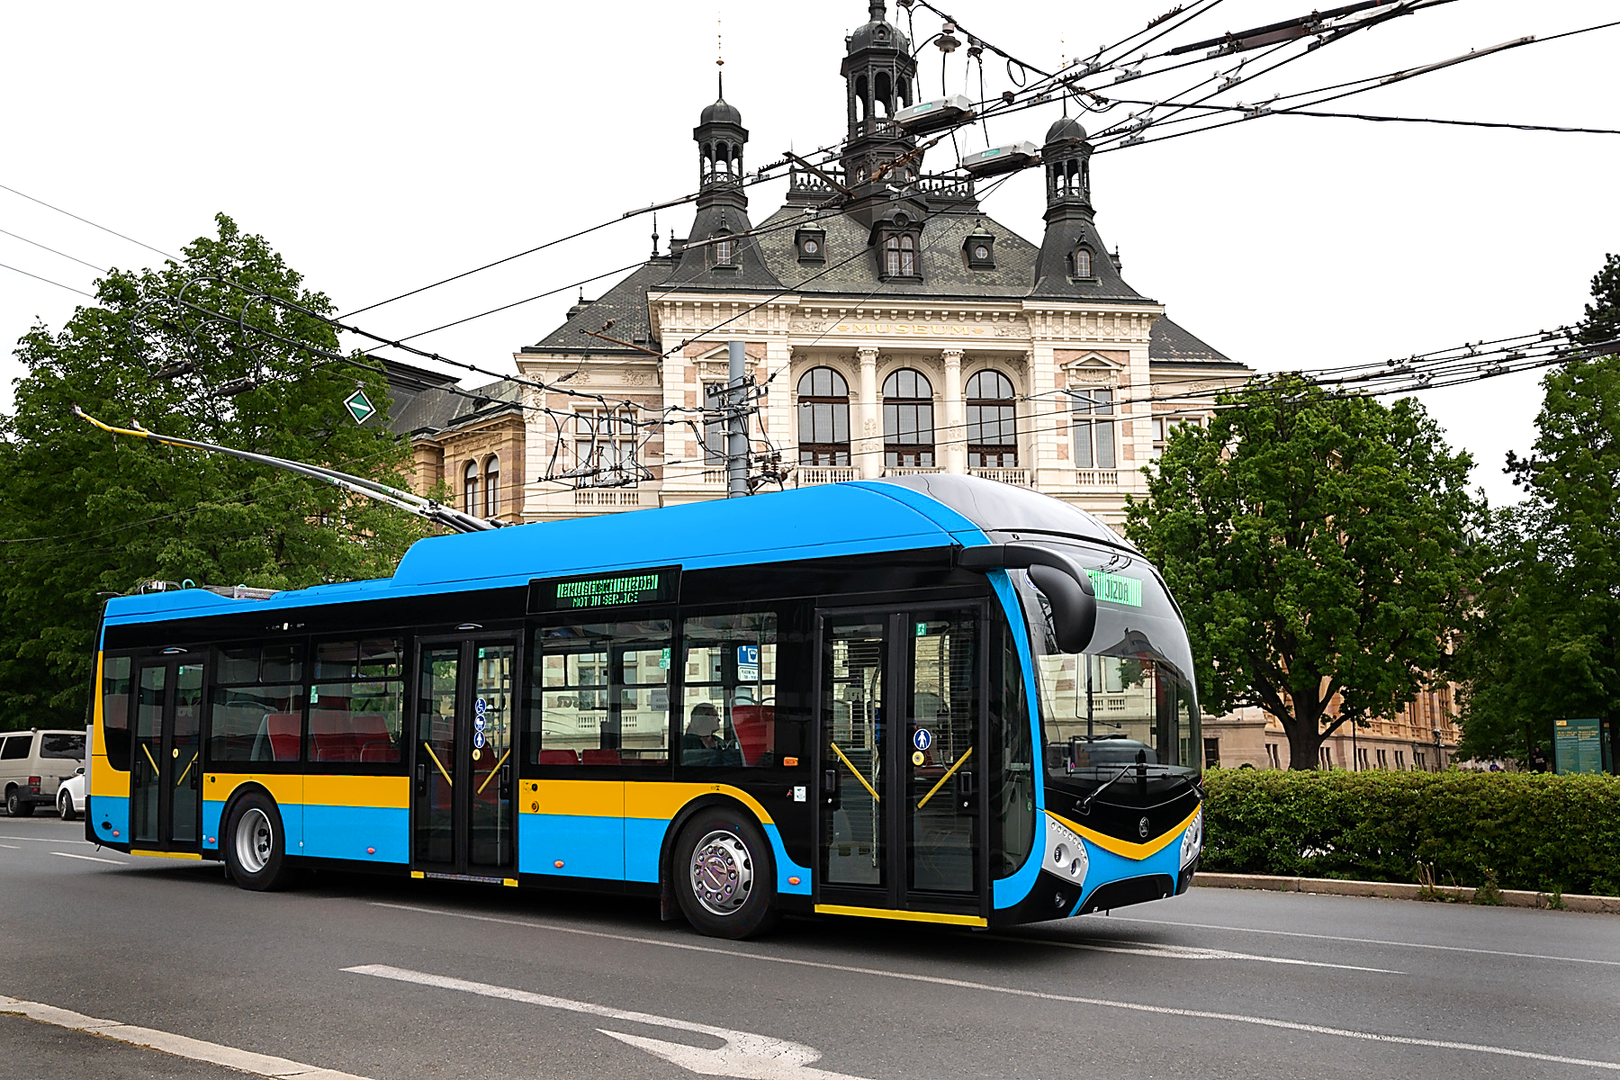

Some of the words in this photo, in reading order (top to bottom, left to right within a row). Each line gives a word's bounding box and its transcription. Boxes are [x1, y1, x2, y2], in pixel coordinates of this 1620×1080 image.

[852, 323, 970, 335] MUSEUM
[572, 596, 589, 607] NOT
[602, 592, 638, 605] SERVICE
